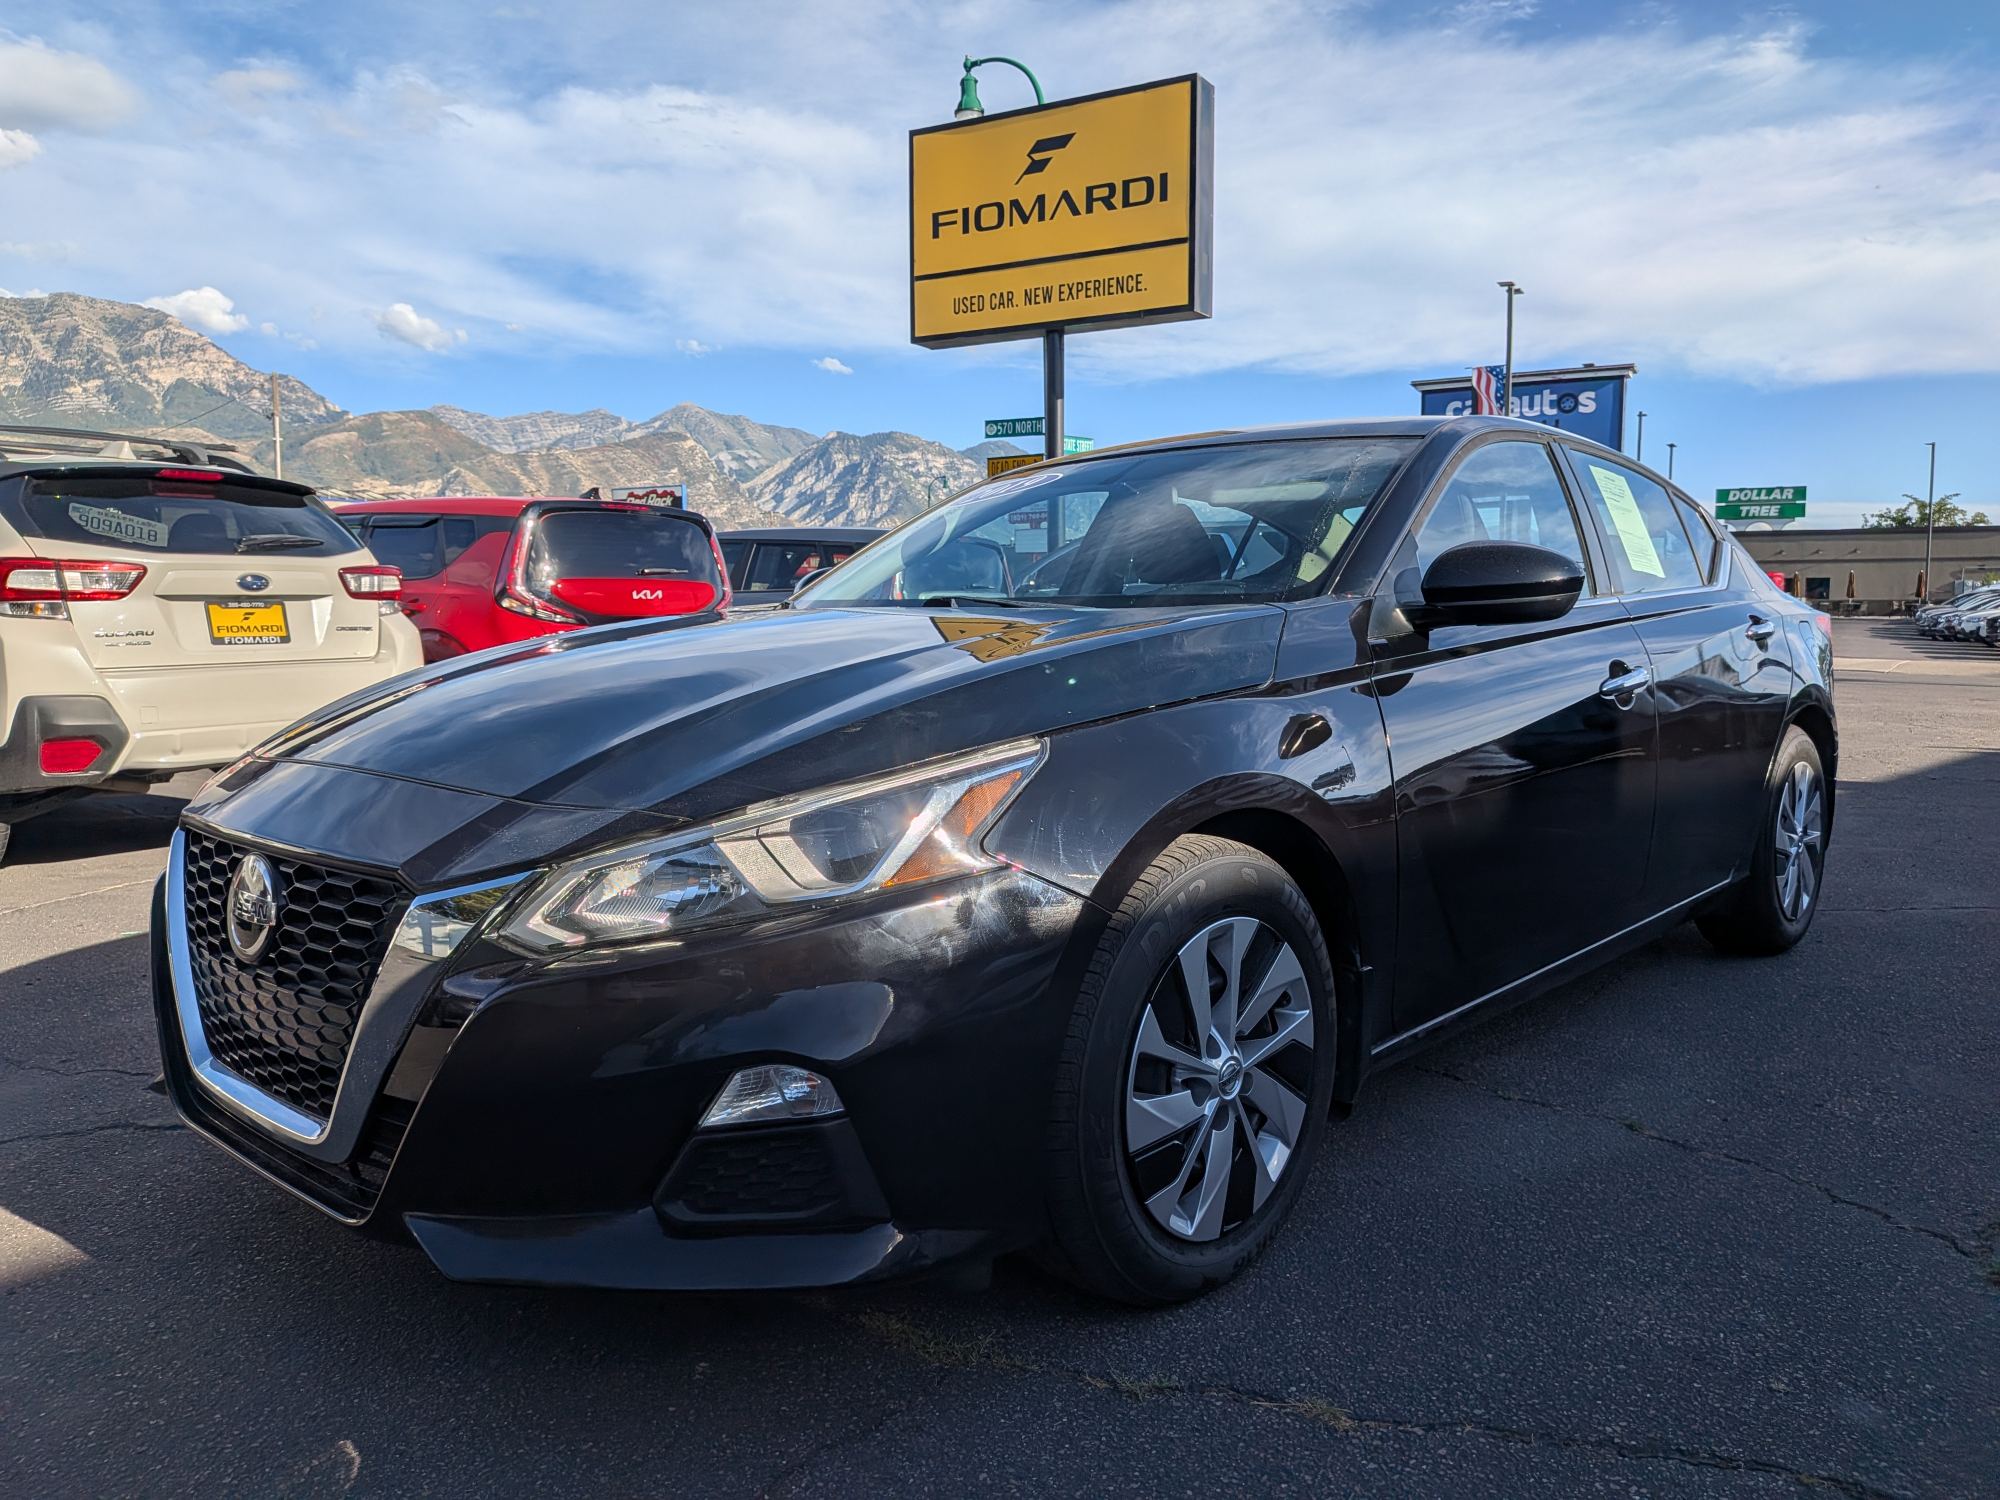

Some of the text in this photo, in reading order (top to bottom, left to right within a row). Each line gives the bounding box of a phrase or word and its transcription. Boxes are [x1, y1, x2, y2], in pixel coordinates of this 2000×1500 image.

[931, 172, 1169, 240] FIOMARDI
[953, 273, 1148, 315] USED CAR. NEW EXPERIENCE.
[997, 420, 1042, 435] 570 NORTH
[1727, 488, 1794, 502] DOLLAR
[1739, 505, 1781, 517] TREE
[632, 589, 663, 600] KIA
[216, 625, 283, 634] FIOMARDI
[224, 636, 281, 645] FIOMARDI
